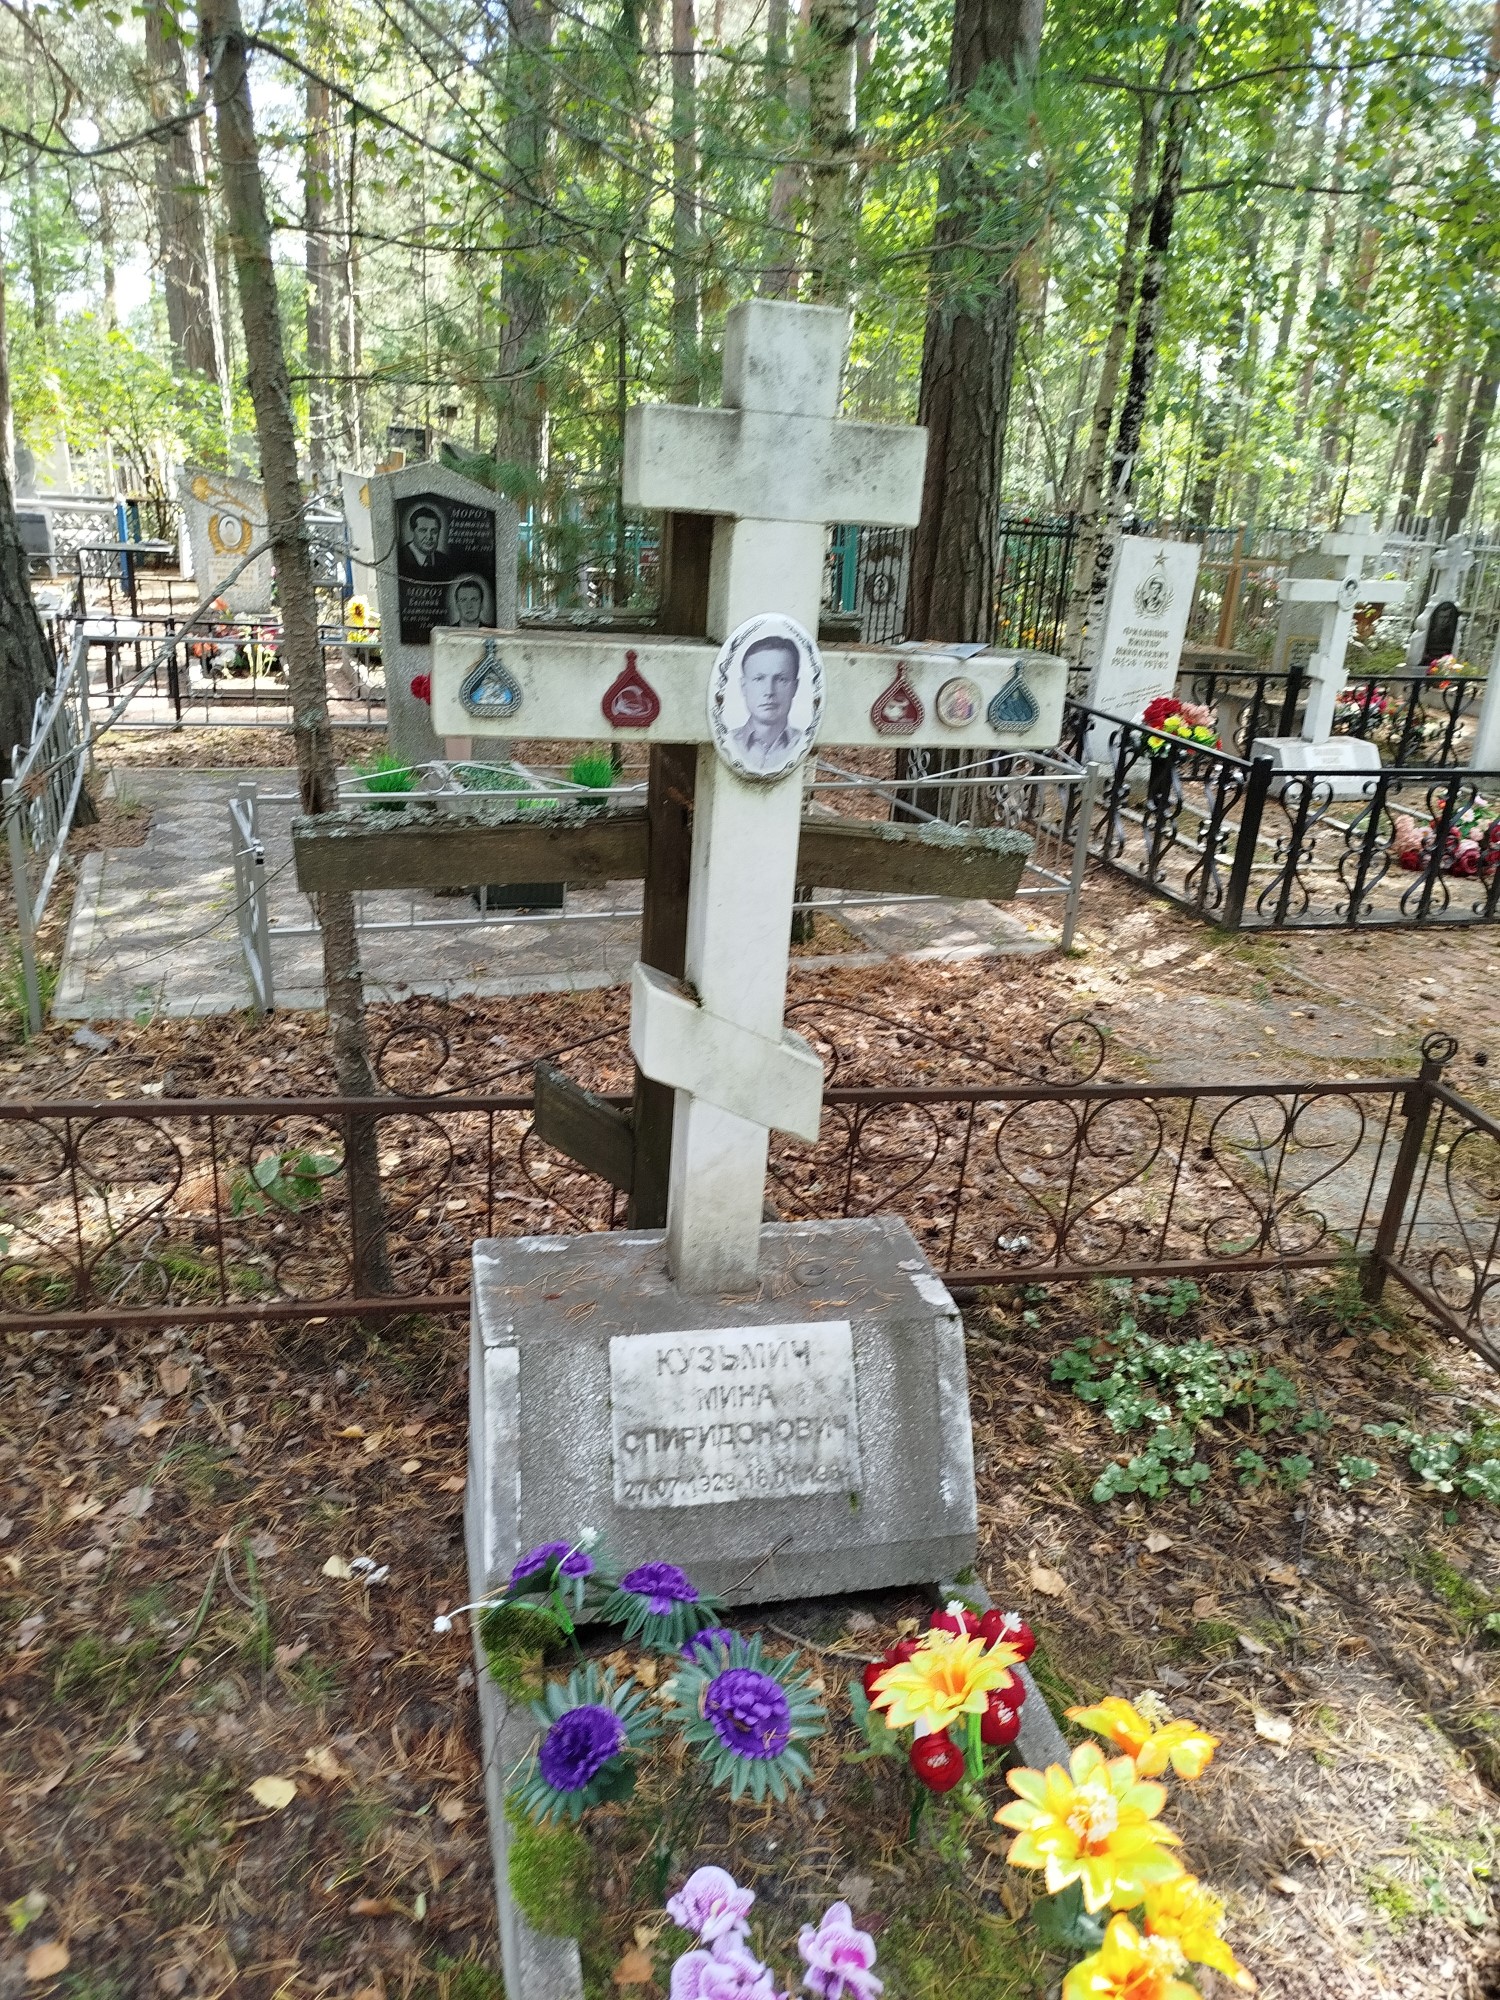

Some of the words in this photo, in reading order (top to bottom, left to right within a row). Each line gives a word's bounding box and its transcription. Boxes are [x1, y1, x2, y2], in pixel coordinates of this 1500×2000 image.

[450, 508, 488, 519] МОРОЗ
[405, 587, 443, 598] МОРОЗ
[656, 1340, 811, 1377] КУЗЬМИЧ
[697, 1383, 775, 1412] МИНА
[622, 1413, 850, 1454] СПИРИДОНОВИЧ
